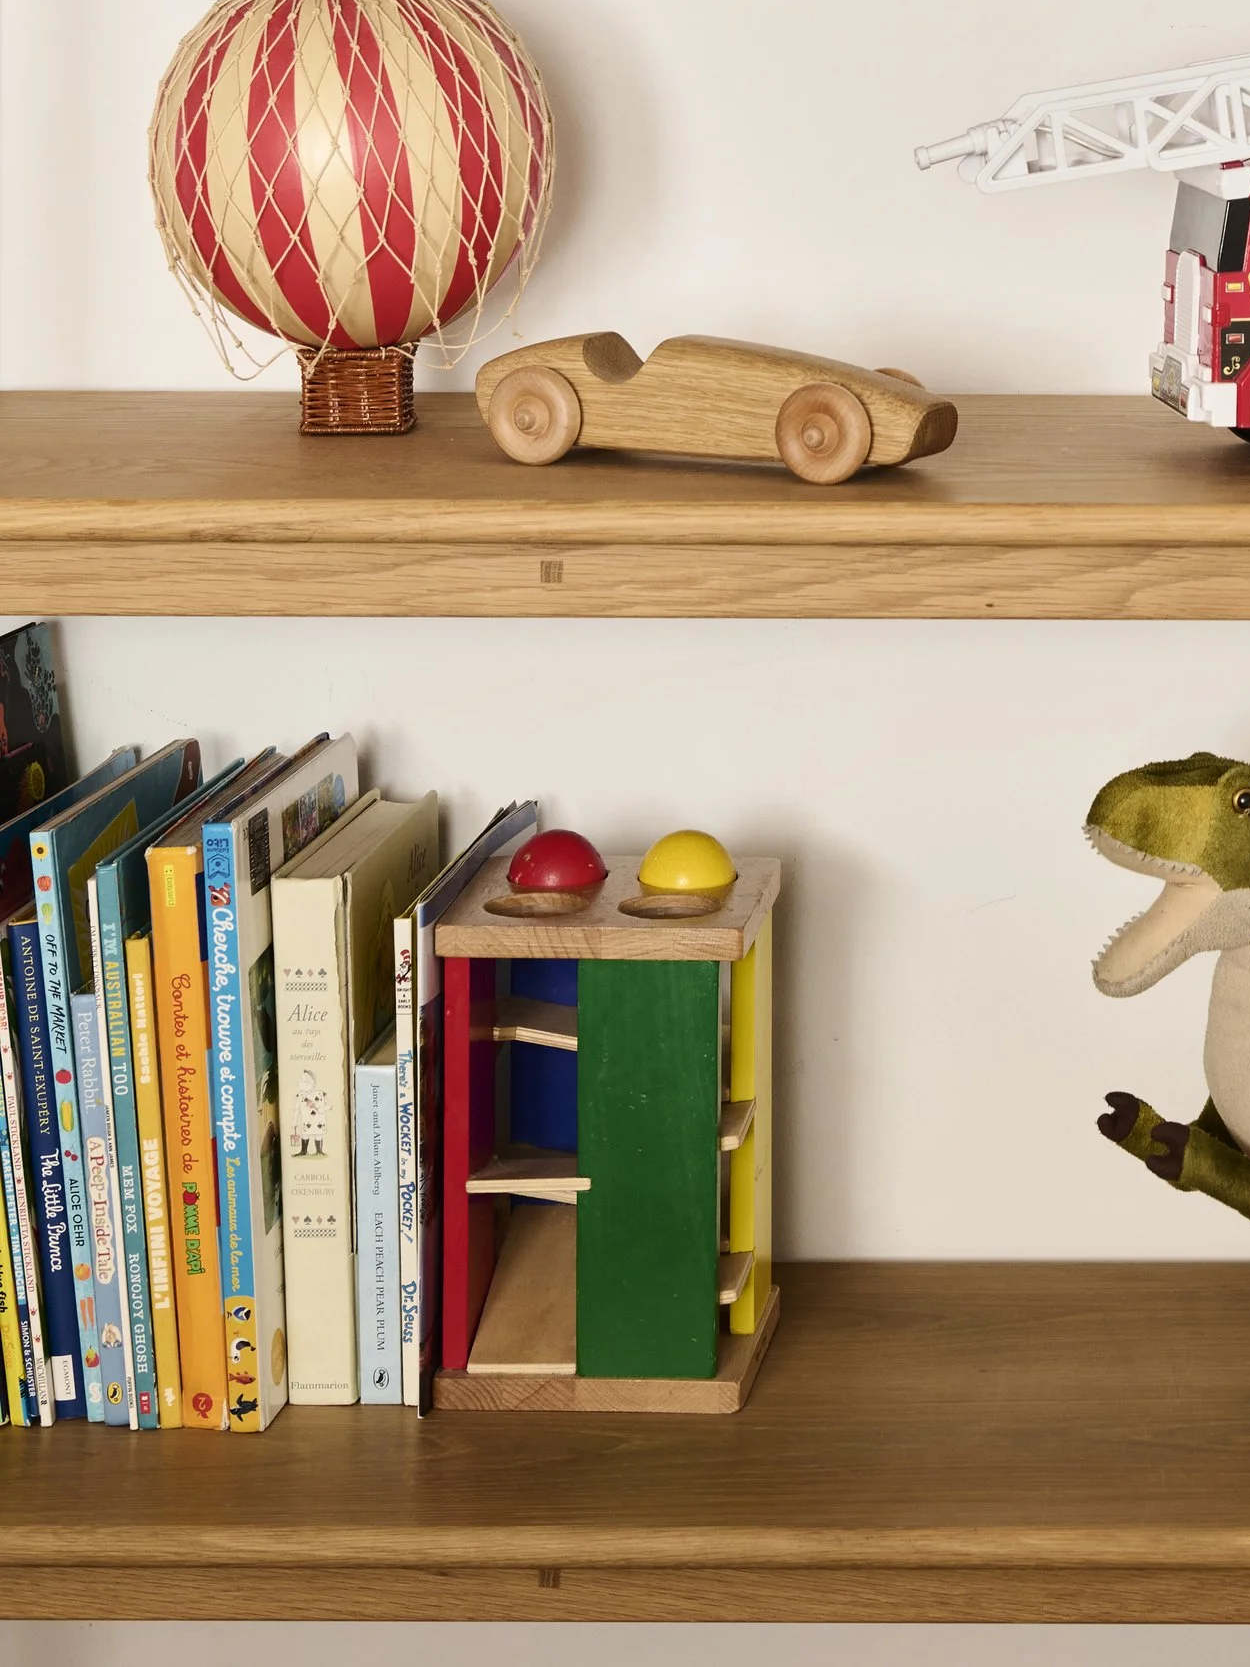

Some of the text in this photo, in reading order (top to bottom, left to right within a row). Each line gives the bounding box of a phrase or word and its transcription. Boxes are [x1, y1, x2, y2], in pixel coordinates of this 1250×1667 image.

[206, 838, 229, 847] Lito
[21, 936, 36, 1002] ANTOINE
[45, 934, 67, 1054] OFF TO THE MARKET
[28, 1005, 39, 1023] DE
[77, 1011, 93, 1053] Peter
[102, 922, 128, 1095] I'M AUSTRALIAN TOO
[133, 973, 151, 1085] Sachie Hattori
[171, 974, 192, 1038] Contes
[211, 907, 241, 1152] Cherche, trouve et compte
[287, 1004, 329, 1023] Alice
[292, 1028, 304, 1036] au
[175, 1044, 192, 1061] et
[301, 1039, 313, 1048] des
[399, 1050, 414, 1088] There's
[7, 1095, 22, 1171] PAUL STICKLAND
[176, 1067, 197, 1147] histoires
[400, 1102, 414, 1156] WOCKET
[181, 1153, 200, 1174] de
[371, 1083, 382, 1195] Janet and Allan Ahlberg
[402, 1157, 408, 1165] in
[2, 1150, 17, 1226] GARETH PETER
[122, 1165, 138, 1234] MEM FOX
[291, 1188, 336, 1196] OXENBURY
[294, 1174, 331, 1182] CARROLL
[400, 1168, 408, 1180] my
[41, 1148, 67, 1272] The Little Prince
[69, 1178, 85, 1247] ALICE OEHR
[89, 1140, 112, 1280] A Peep-Inside Tale
[142, 1139, 171, 1310] L'INFINI VOYAGE
[182, 1182, 202, 1236] POMME
[225, 1156, 244, 1292] Les animaux de la mer
[400, 1182, 416, 1244] POCKET!
[11, 1235, 25, 1301] TIM BUDGEN
[18, 1189, 35, 1293] HENRIETTA STICKLAND
[375, 1212, 385, 1351] EACH PEACH PEAR PLUM
[401, 1281, 418, 1344] Dr. Seuss
[20, 1320, 30, 1348] SIMON
[128, 1253, 149, 1373] RONOJOY GHOSH
[24, 1357, 36, 1398] SCHUSTER
[35, 1357, 47, 1400] MACMILLAN
[62, 1359, 71, 1396] EGMONT
[291, 1381, 349, 1390] Flammarion
